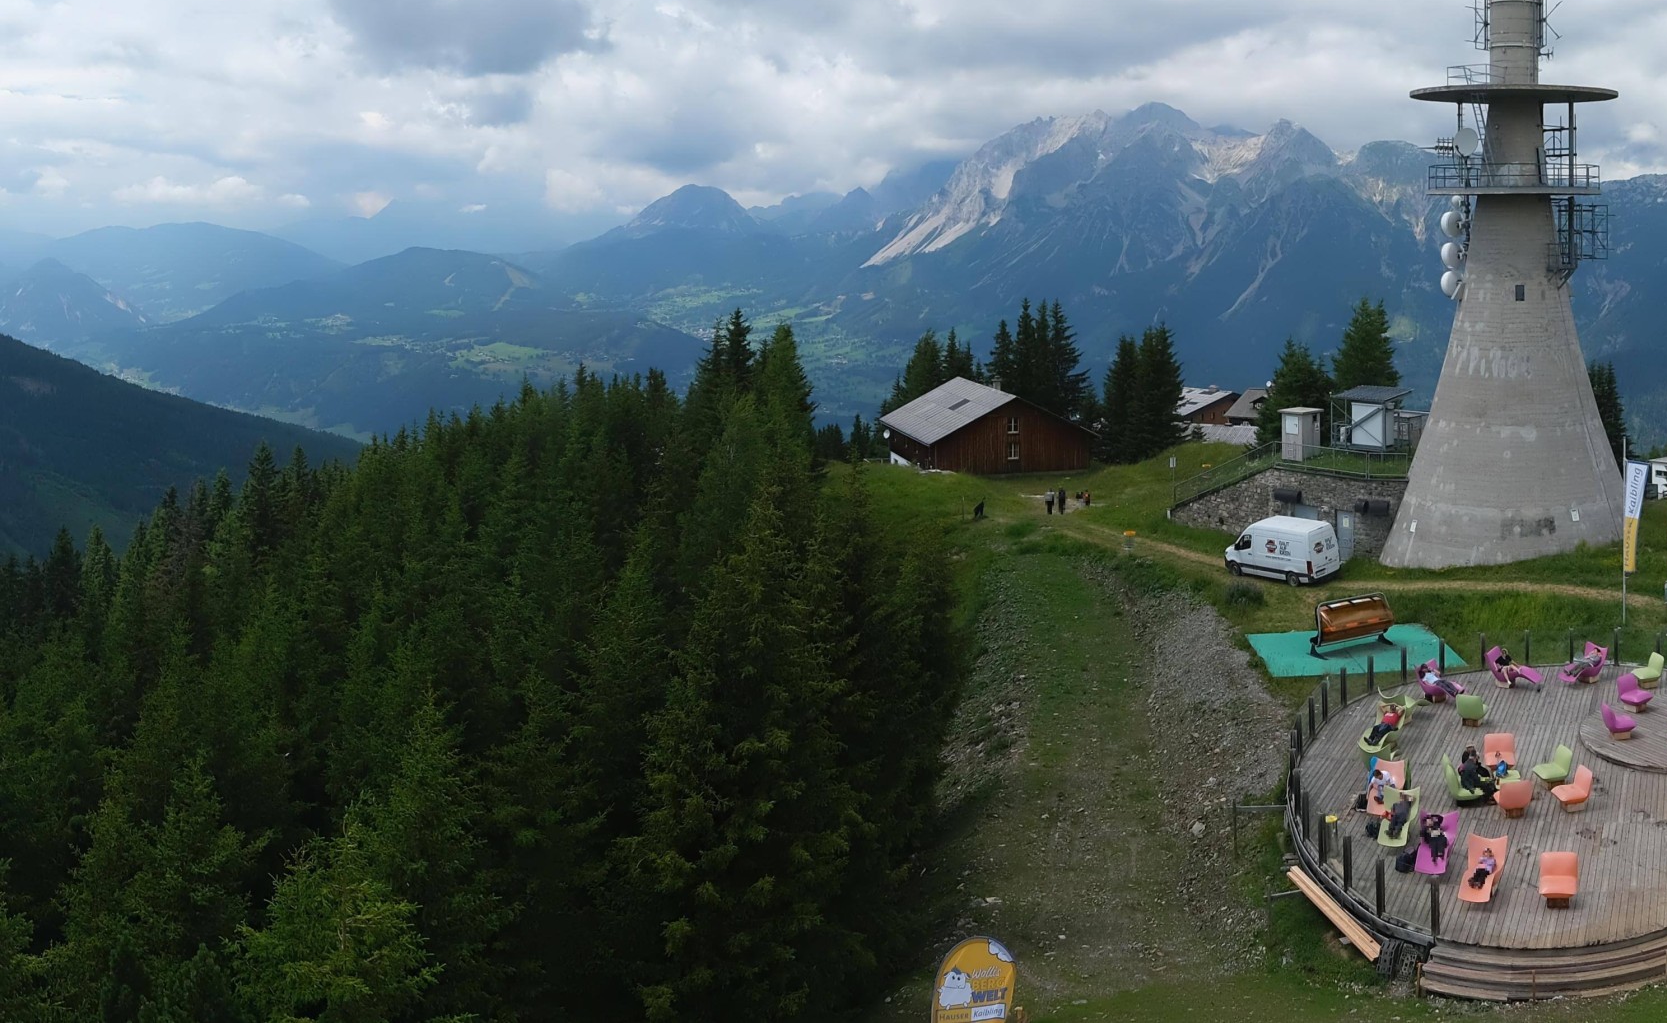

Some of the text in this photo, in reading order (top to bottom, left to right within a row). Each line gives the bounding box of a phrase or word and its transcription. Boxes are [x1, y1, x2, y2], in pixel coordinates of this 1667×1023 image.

[1629, 467, 1643, 515] Kaibling
[972, 979, 1004, 989] BERG
[971, 987, 1007, 1003] WELT
[940, 1007, 1003, 1021] HAUSER Kaibling
